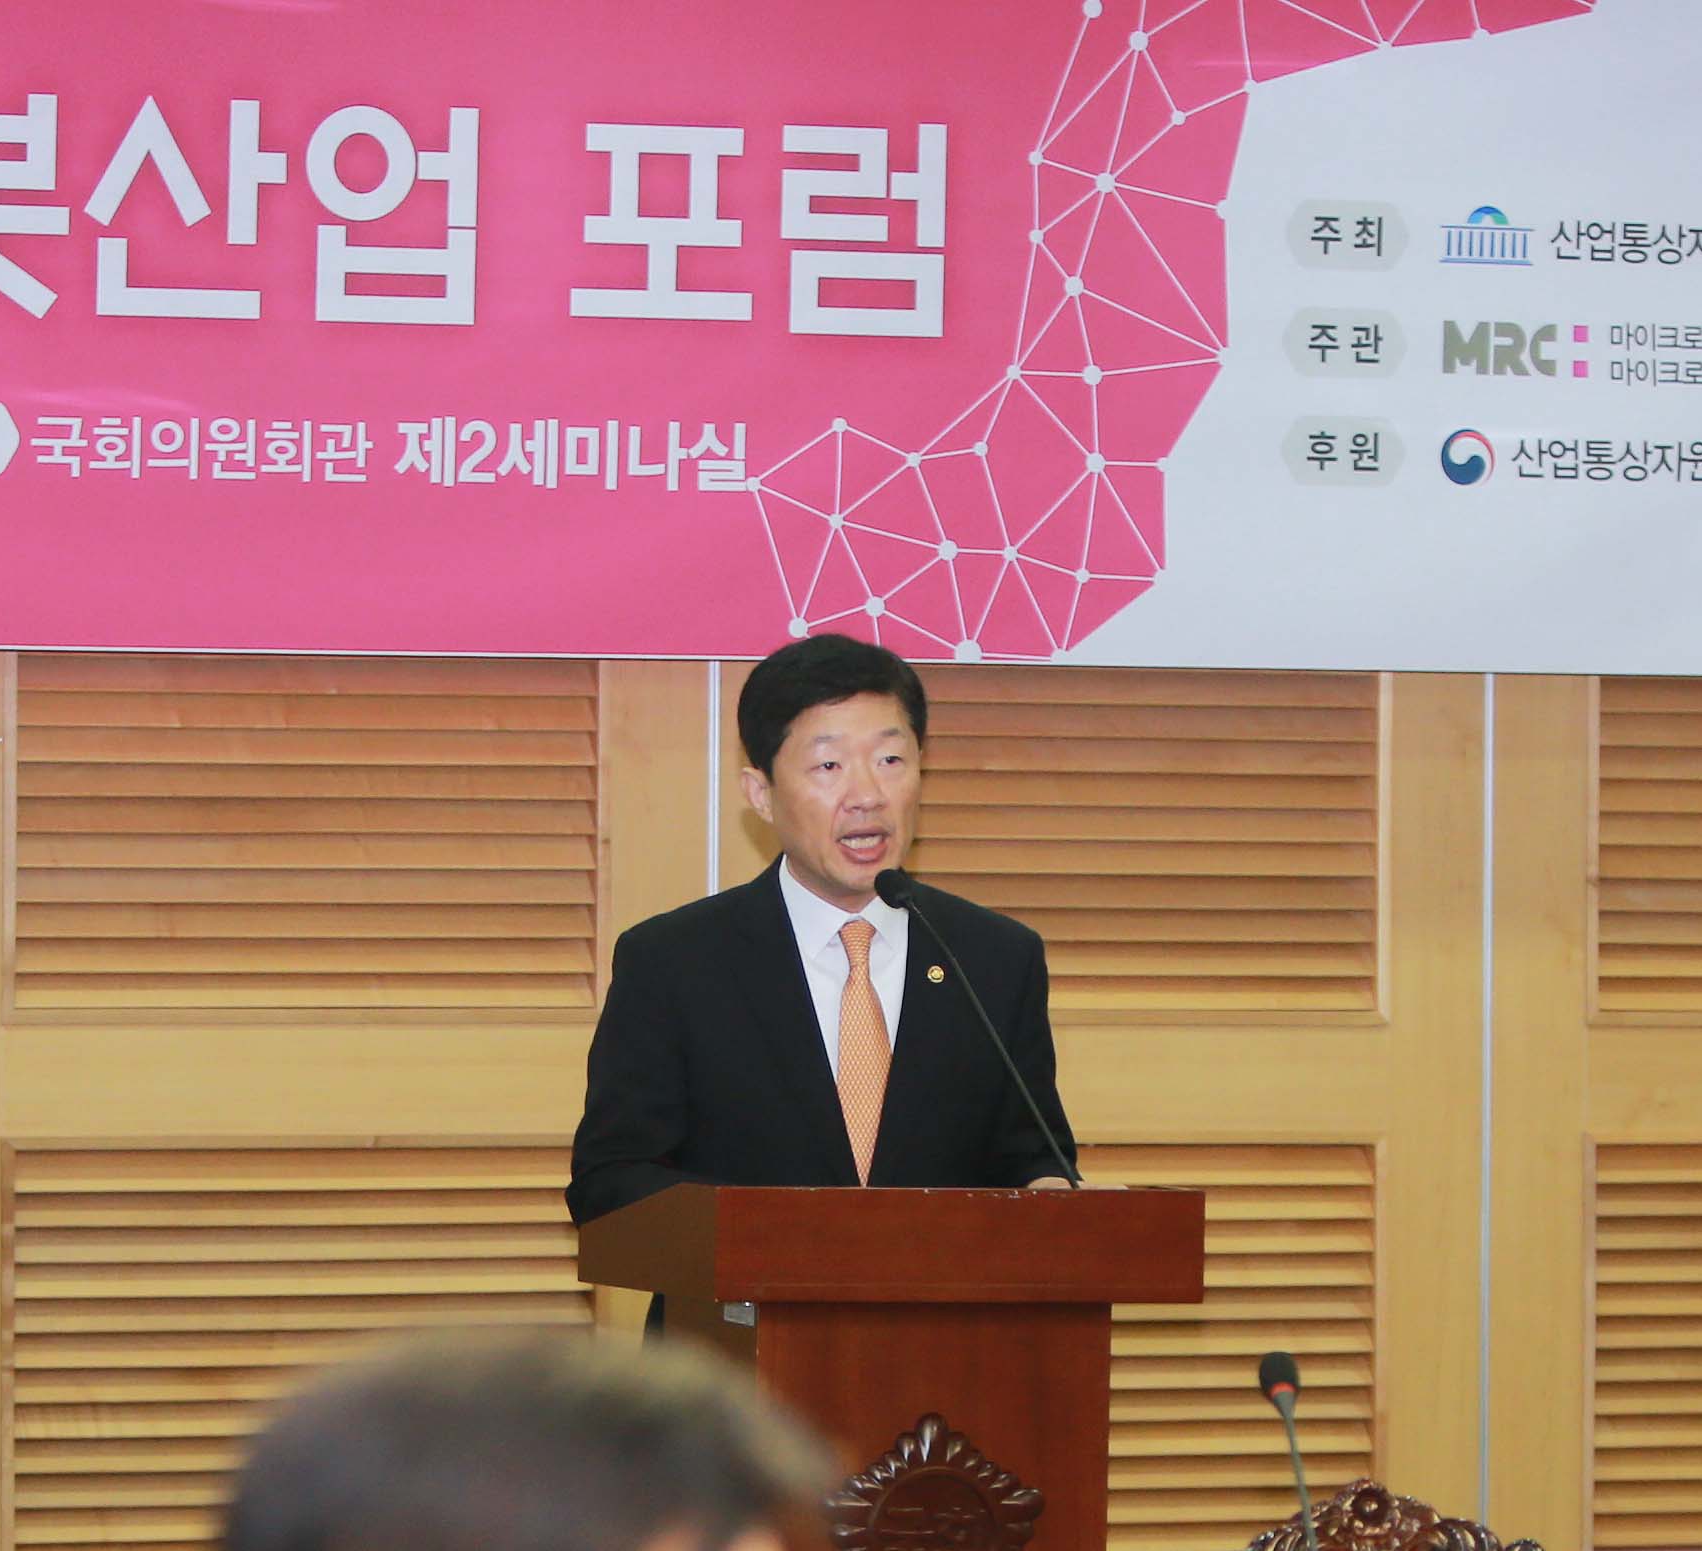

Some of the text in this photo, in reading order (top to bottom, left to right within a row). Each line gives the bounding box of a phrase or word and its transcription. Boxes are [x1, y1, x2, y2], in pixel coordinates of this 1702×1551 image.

[570, 122, 949, 339] 포럼
[1311, 217, 1382, 256] 주최
[1309, 324, 1383, 364] 주관
[30, 416, 747, 491] 국회의원회관 제2세미나실
[1306, 431, 1379, 472] 후원
